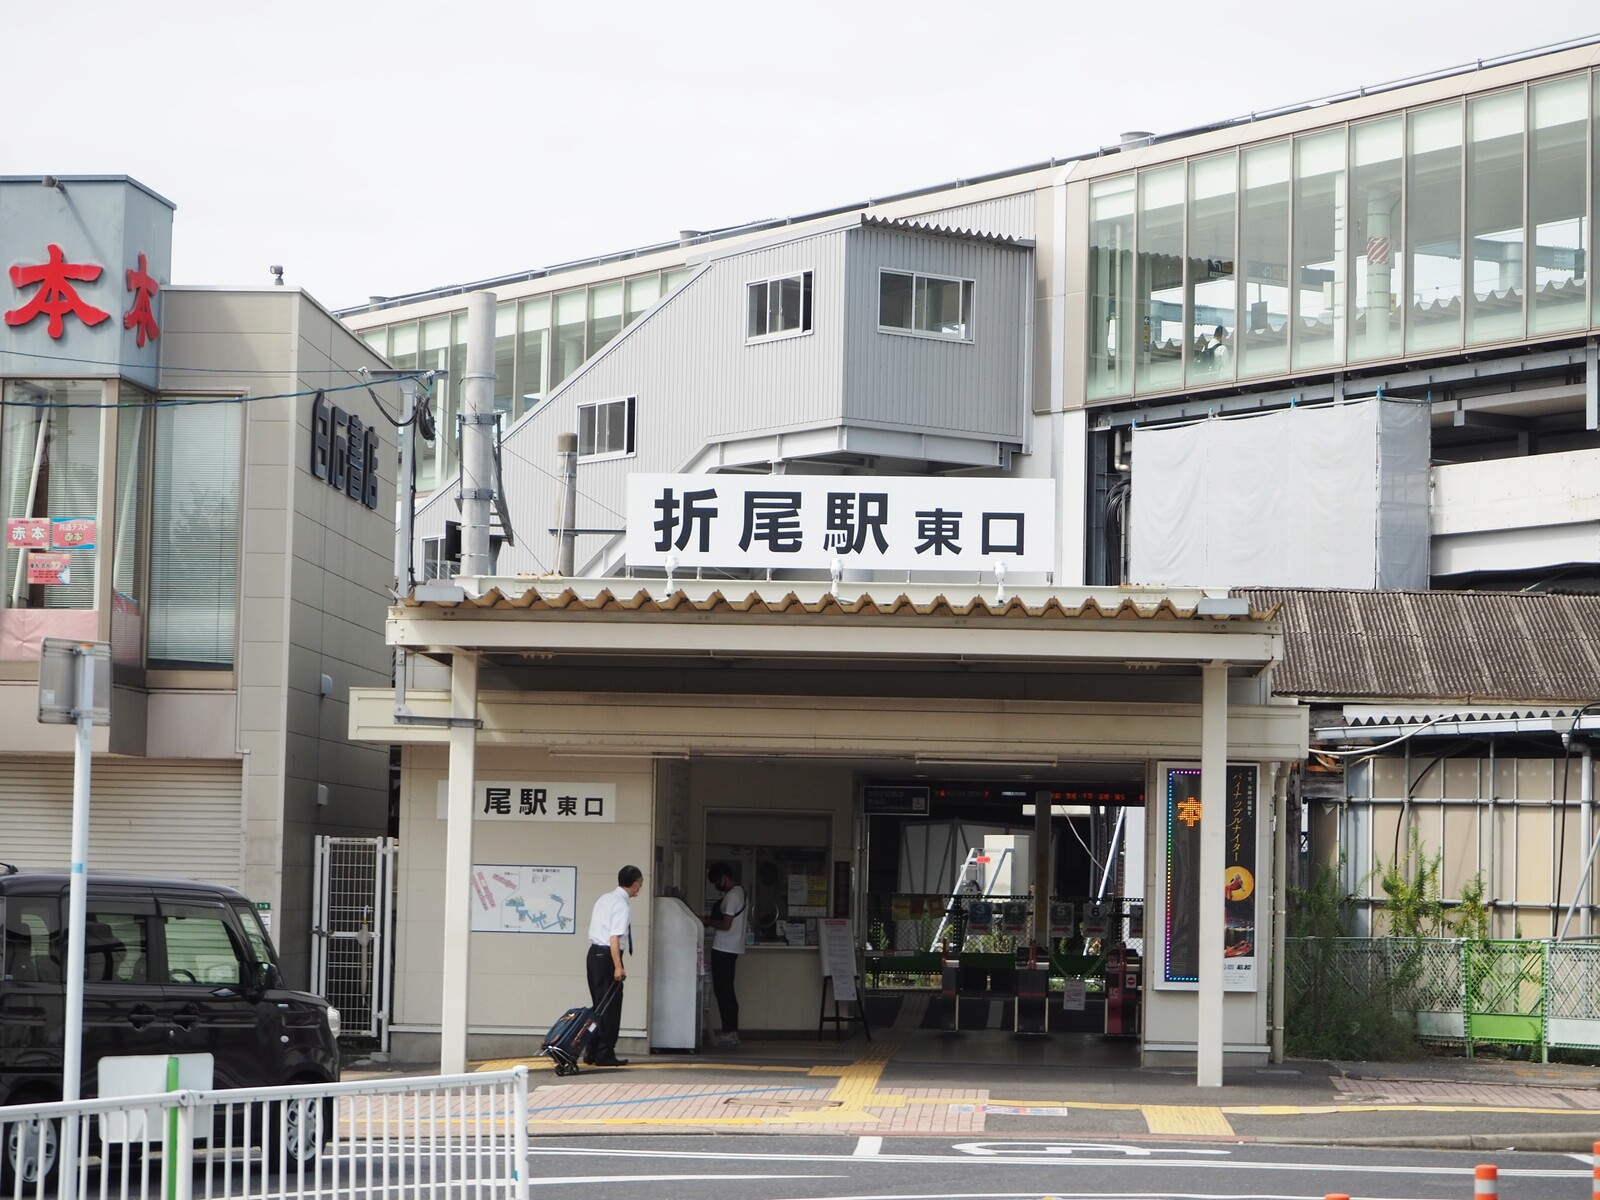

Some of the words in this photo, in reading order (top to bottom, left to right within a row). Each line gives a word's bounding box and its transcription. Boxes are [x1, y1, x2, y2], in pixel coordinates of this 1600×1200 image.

[4, 243, 110, 339] 本
[124, 252, 161, 348] 本
[12, 526, 45, 540] 赤本
[484, 787, 604, 817] 尾駅東口
[1227, 772, 1244, 863] パイナップルナイター
[1091, 907, 1100, 917] 6
